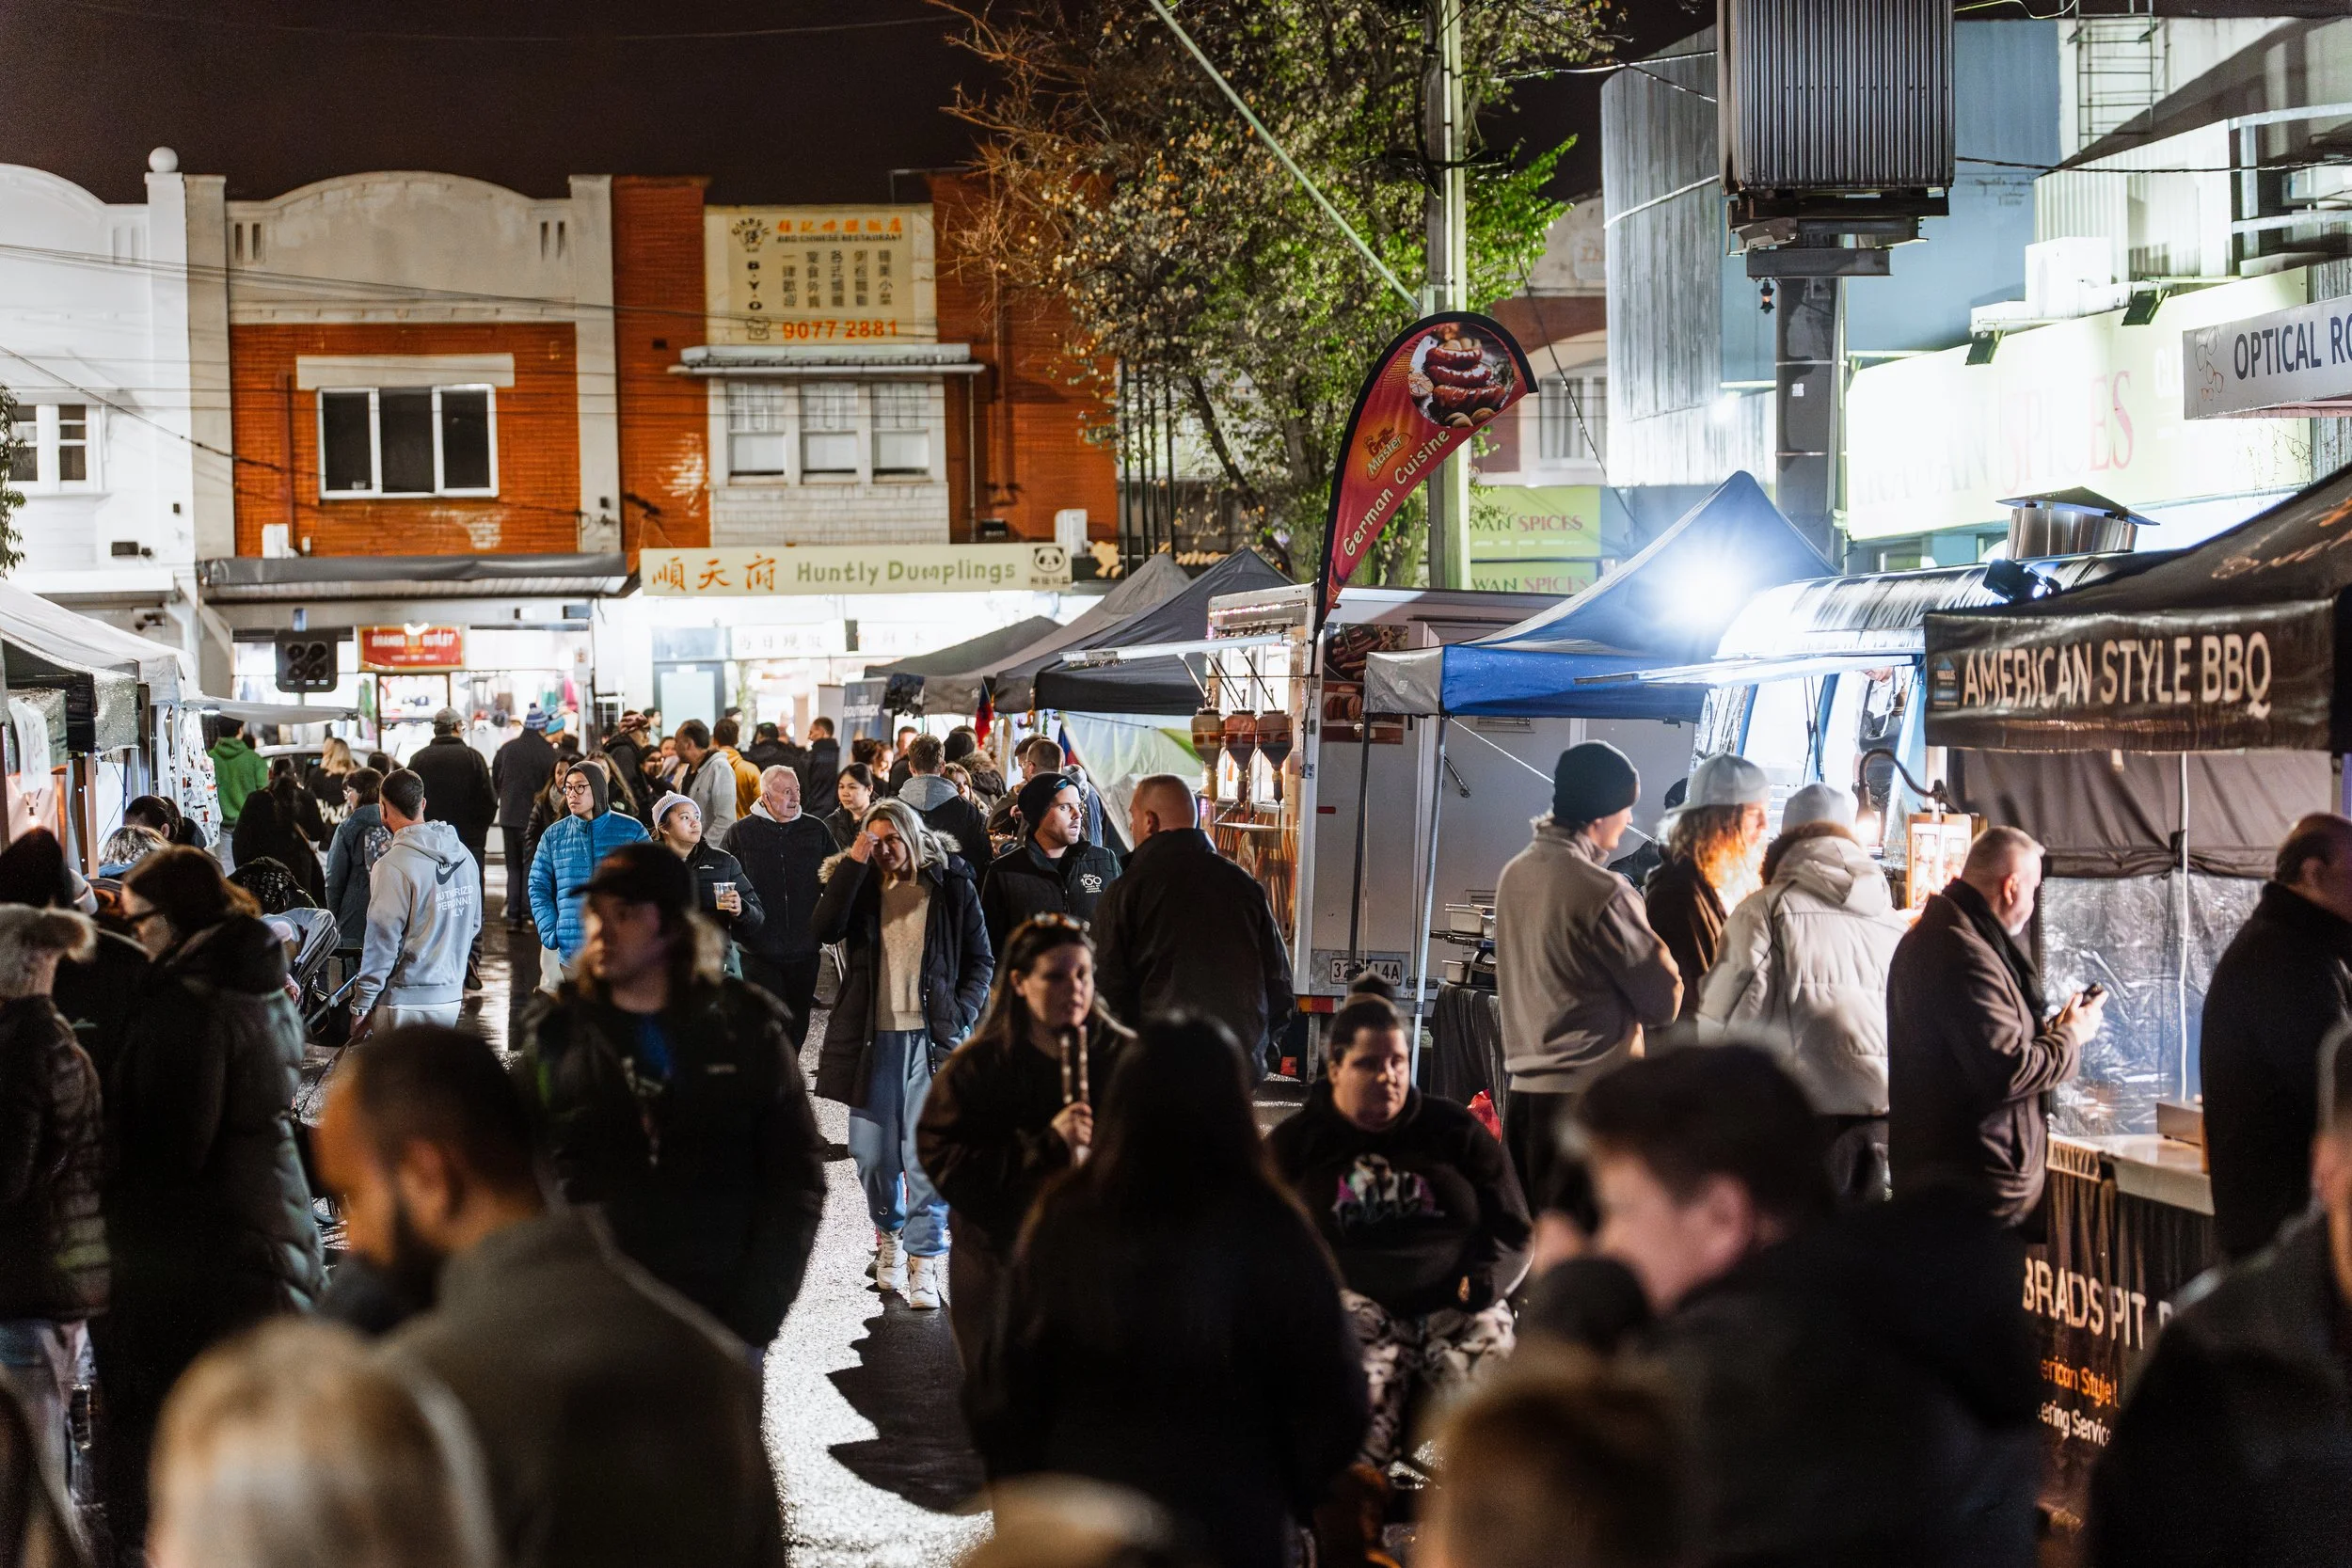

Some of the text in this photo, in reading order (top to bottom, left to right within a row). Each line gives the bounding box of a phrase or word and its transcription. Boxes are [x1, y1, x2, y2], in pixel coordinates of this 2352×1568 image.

[842, 233, 903, 243] RESTAURANT
[783, 320, 898, 340] 9077 2881
[2233, 321, 2322, 381] OPTICAL
[1367, 435, 1403, 475] Master
[1343, 429, 1451, 558] German Cuisine
[1518, 515, 1582, 531] SPICES
[652, 553, 778, 594] 順天府
[797, 559, 1016, 588] Huntly Dumplings
[1963, 642, 2092, 708] AMERICAN
[2099, 637, 2192, 705] STYLE
[2201, 631, 2272, 720] BBQ
[1081, 877, 1103, 887] 100
[2022, 1257, 2106, 1338] BRADS
[2110, 1285, 2148, 1350] PIT
[2080, 1366, 2112, 1408] Style
